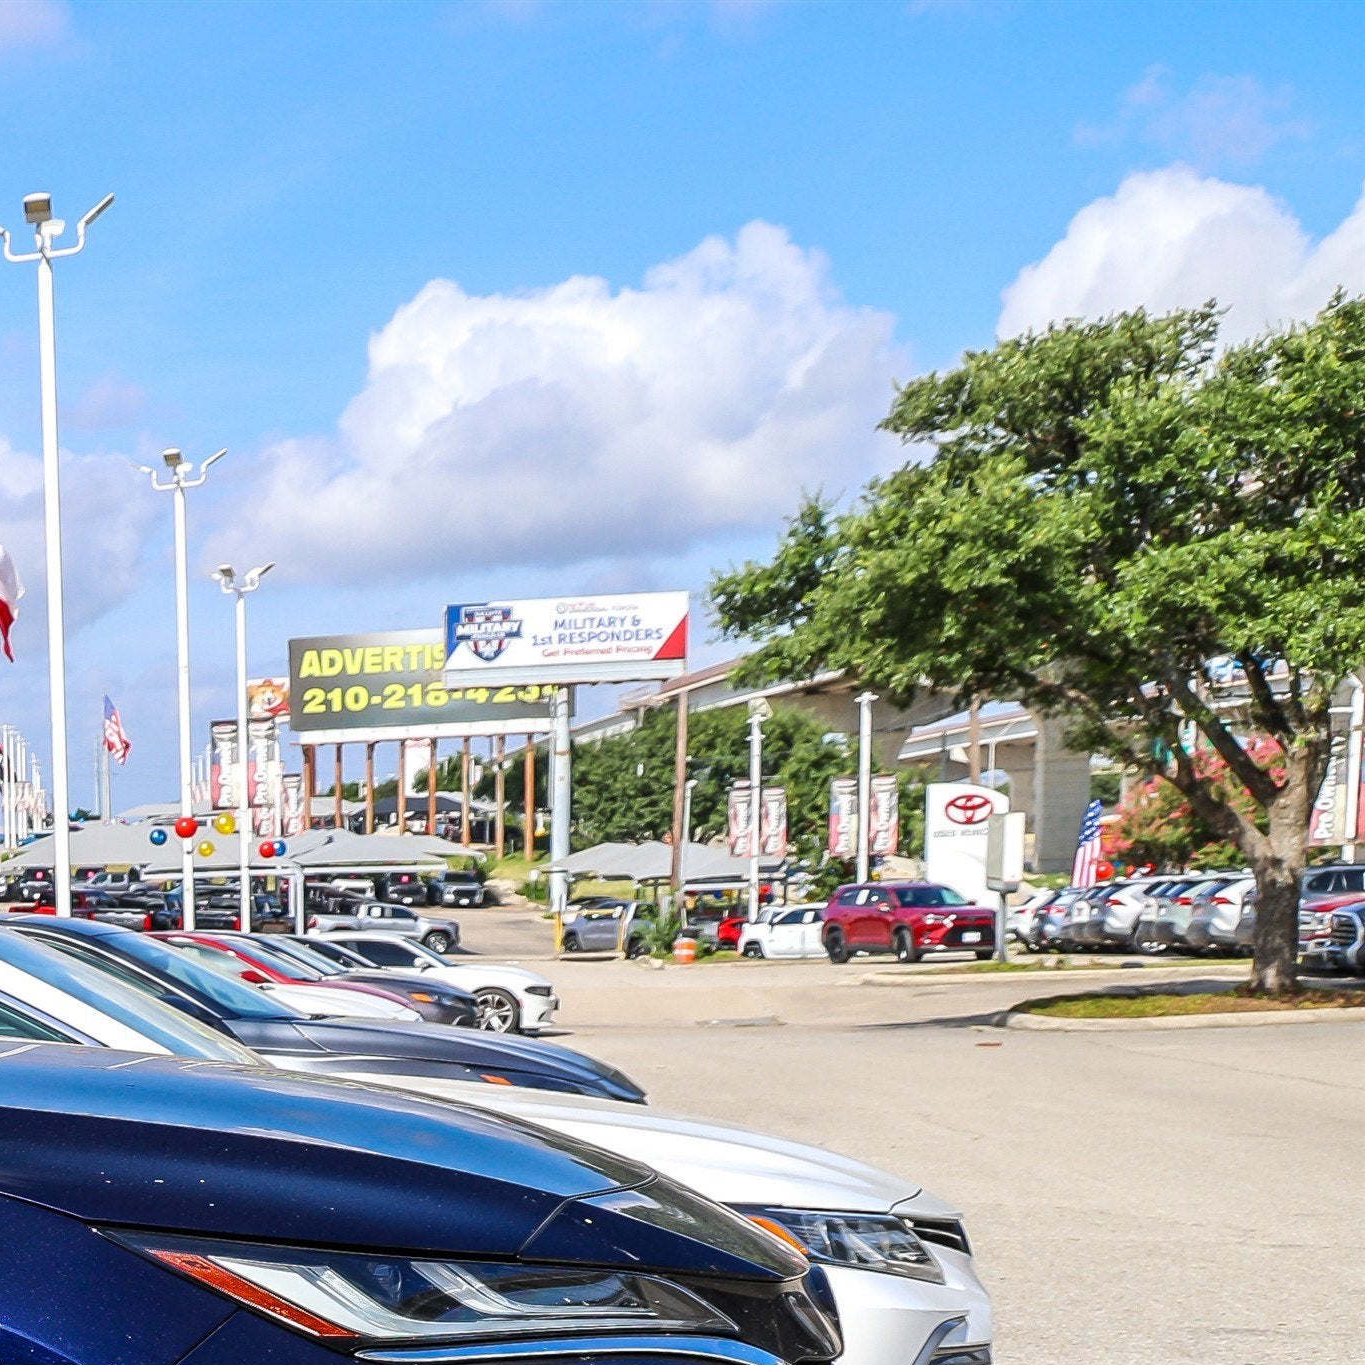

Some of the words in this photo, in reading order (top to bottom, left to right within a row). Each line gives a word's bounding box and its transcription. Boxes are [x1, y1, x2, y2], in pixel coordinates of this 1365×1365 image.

[455, 621, 521, 636] MILITARY
[554, 616, 627, 630] MILITARY
[631, 615, 642, 627] &
[532, 634, 553, 646] 1st
[558, 628, 664, 645] RESPONDERS
[299, 643, 446, 679] ADVERTIS
[1313, 811, 1335, 840] Pre
